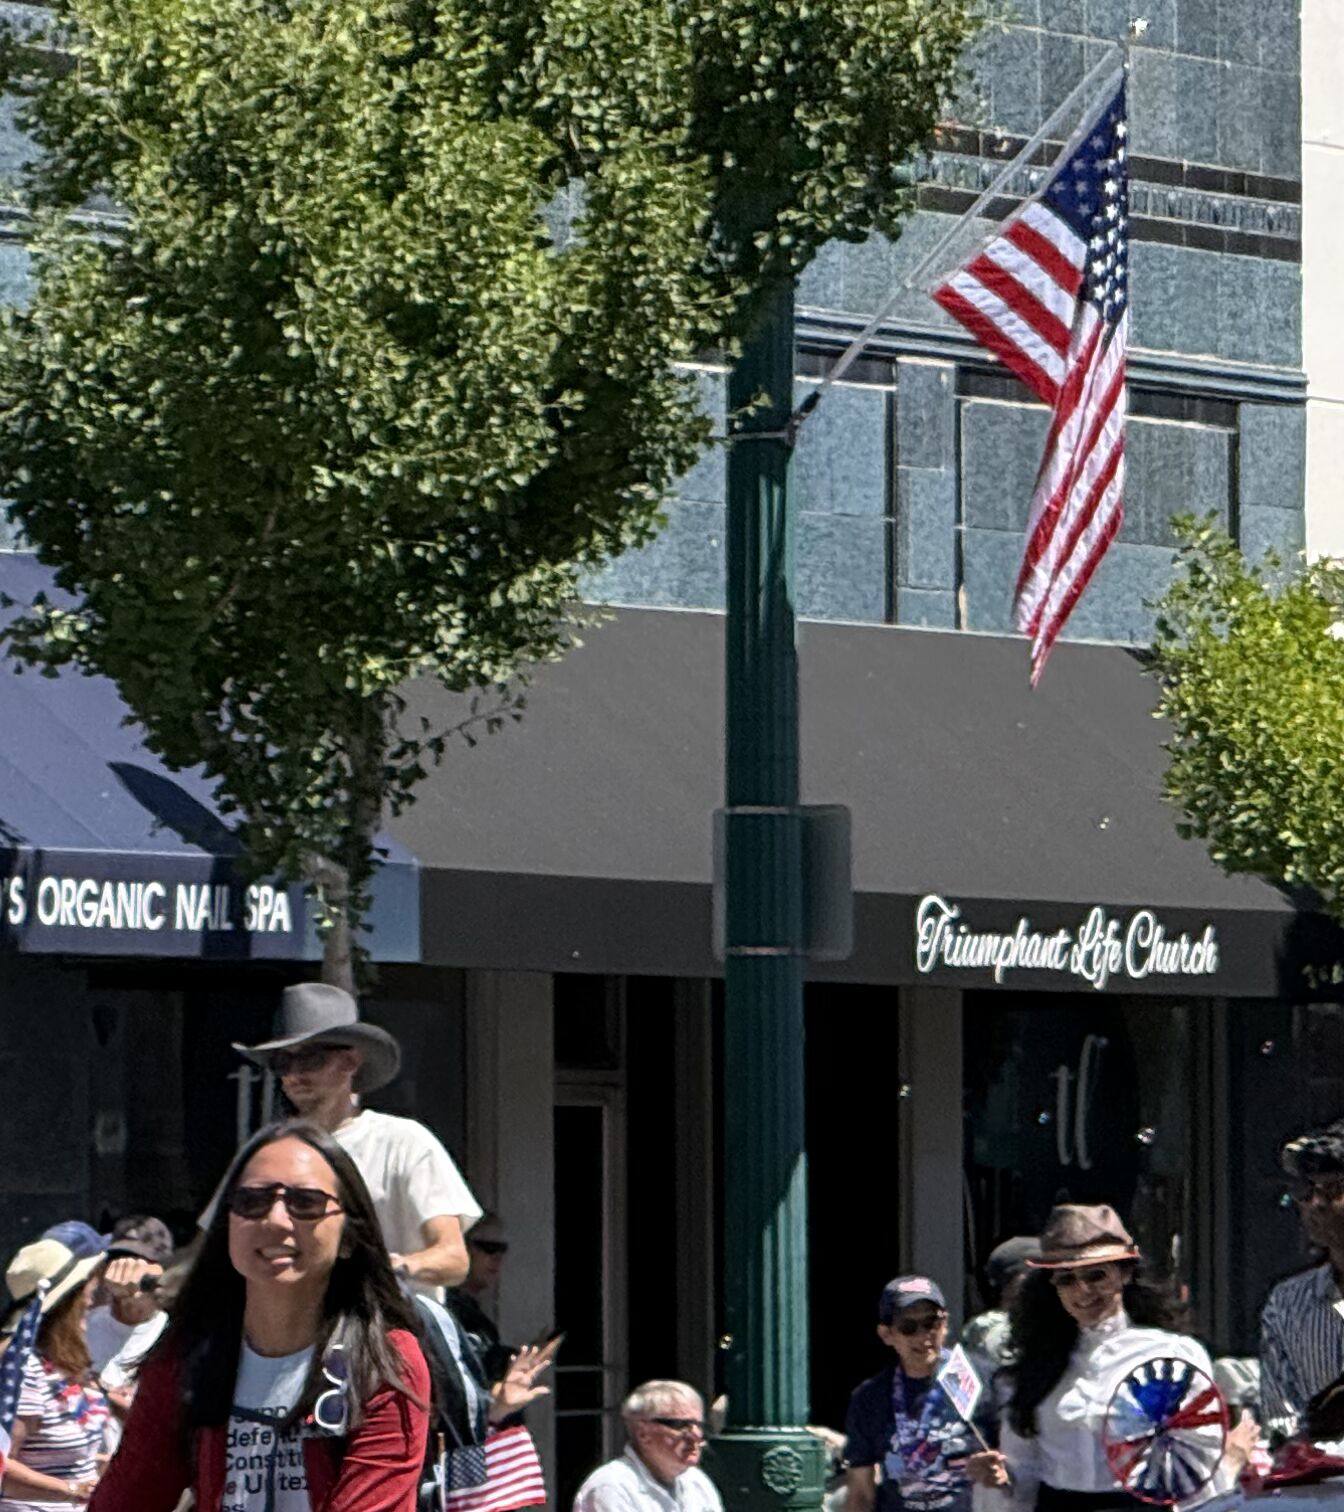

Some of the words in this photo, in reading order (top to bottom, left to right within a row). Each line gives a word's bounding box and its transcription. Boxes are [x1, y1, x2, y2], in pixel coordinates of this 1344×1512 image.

[37, 876, 166, 930] ORGANIC
[176, 884, 233, 931] NAIL
[244, 884, 293, 932] SPA
[916, 894, 1073, 985] Triumphant
[1071, 906, 1123, 990] Life
[1125, 910, 1218, 979] Church
